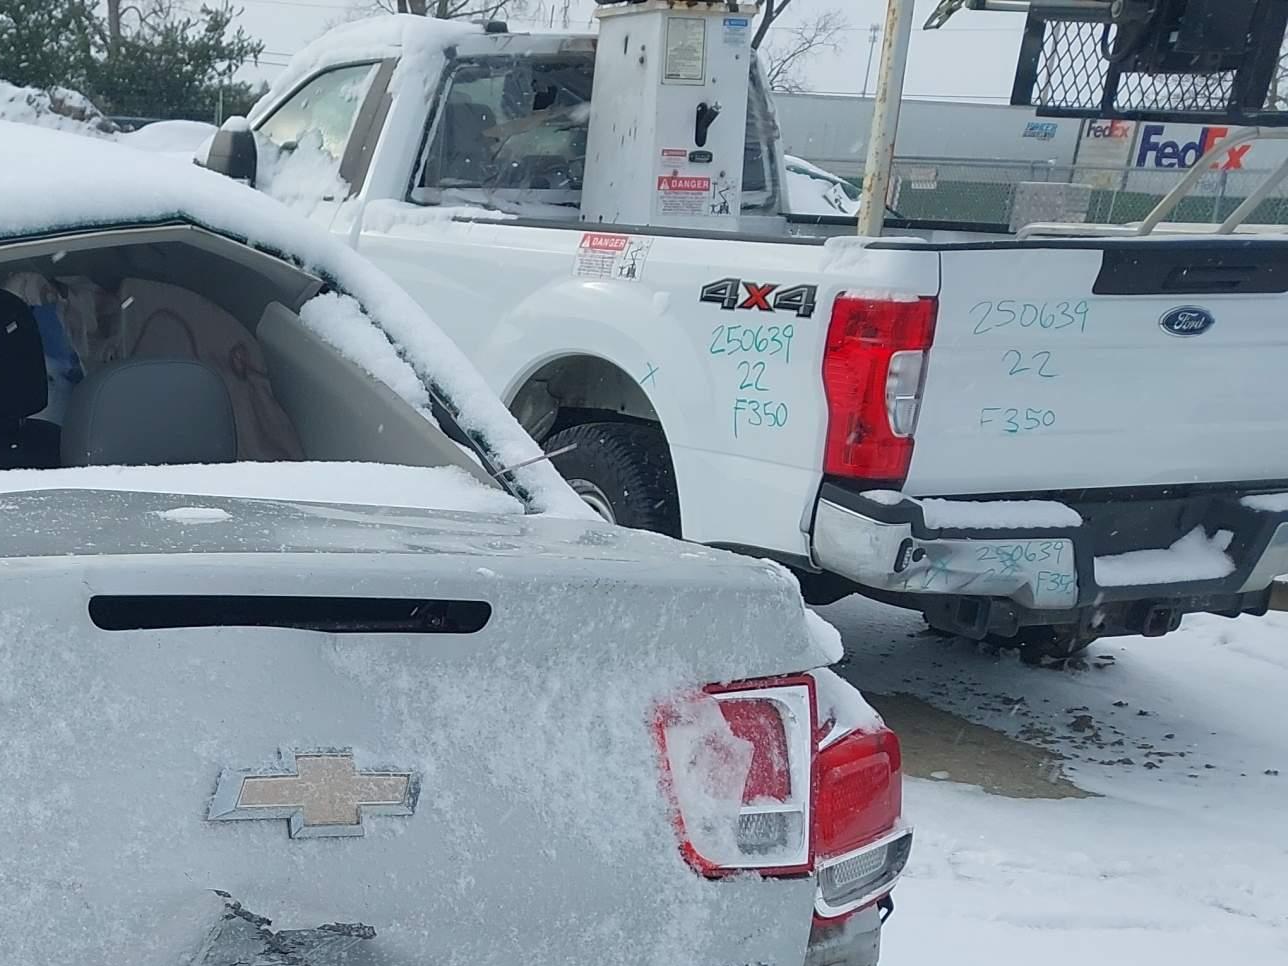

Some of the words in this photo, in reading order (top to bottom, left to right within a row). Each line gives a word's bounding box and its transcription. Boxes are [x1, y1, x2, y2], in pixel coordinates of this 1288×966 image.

[1086, 119, 1130, 138] FedEx
[671, 180, 709, 189] DANGER
[592, 237, 626, 248] DANGER
[969, 300, 1089, 335] 250639
[1174, 312, 1205, 330] Ford
[710, 324, 794, 363] 250639
[737, 361, 770, 391] 22
[1002, 349, 1060, 377] 22
[734, 399, 788, 438] F350
[980, 407, 1056, 433] F350
[976, 541, 1064, 565] 250639
